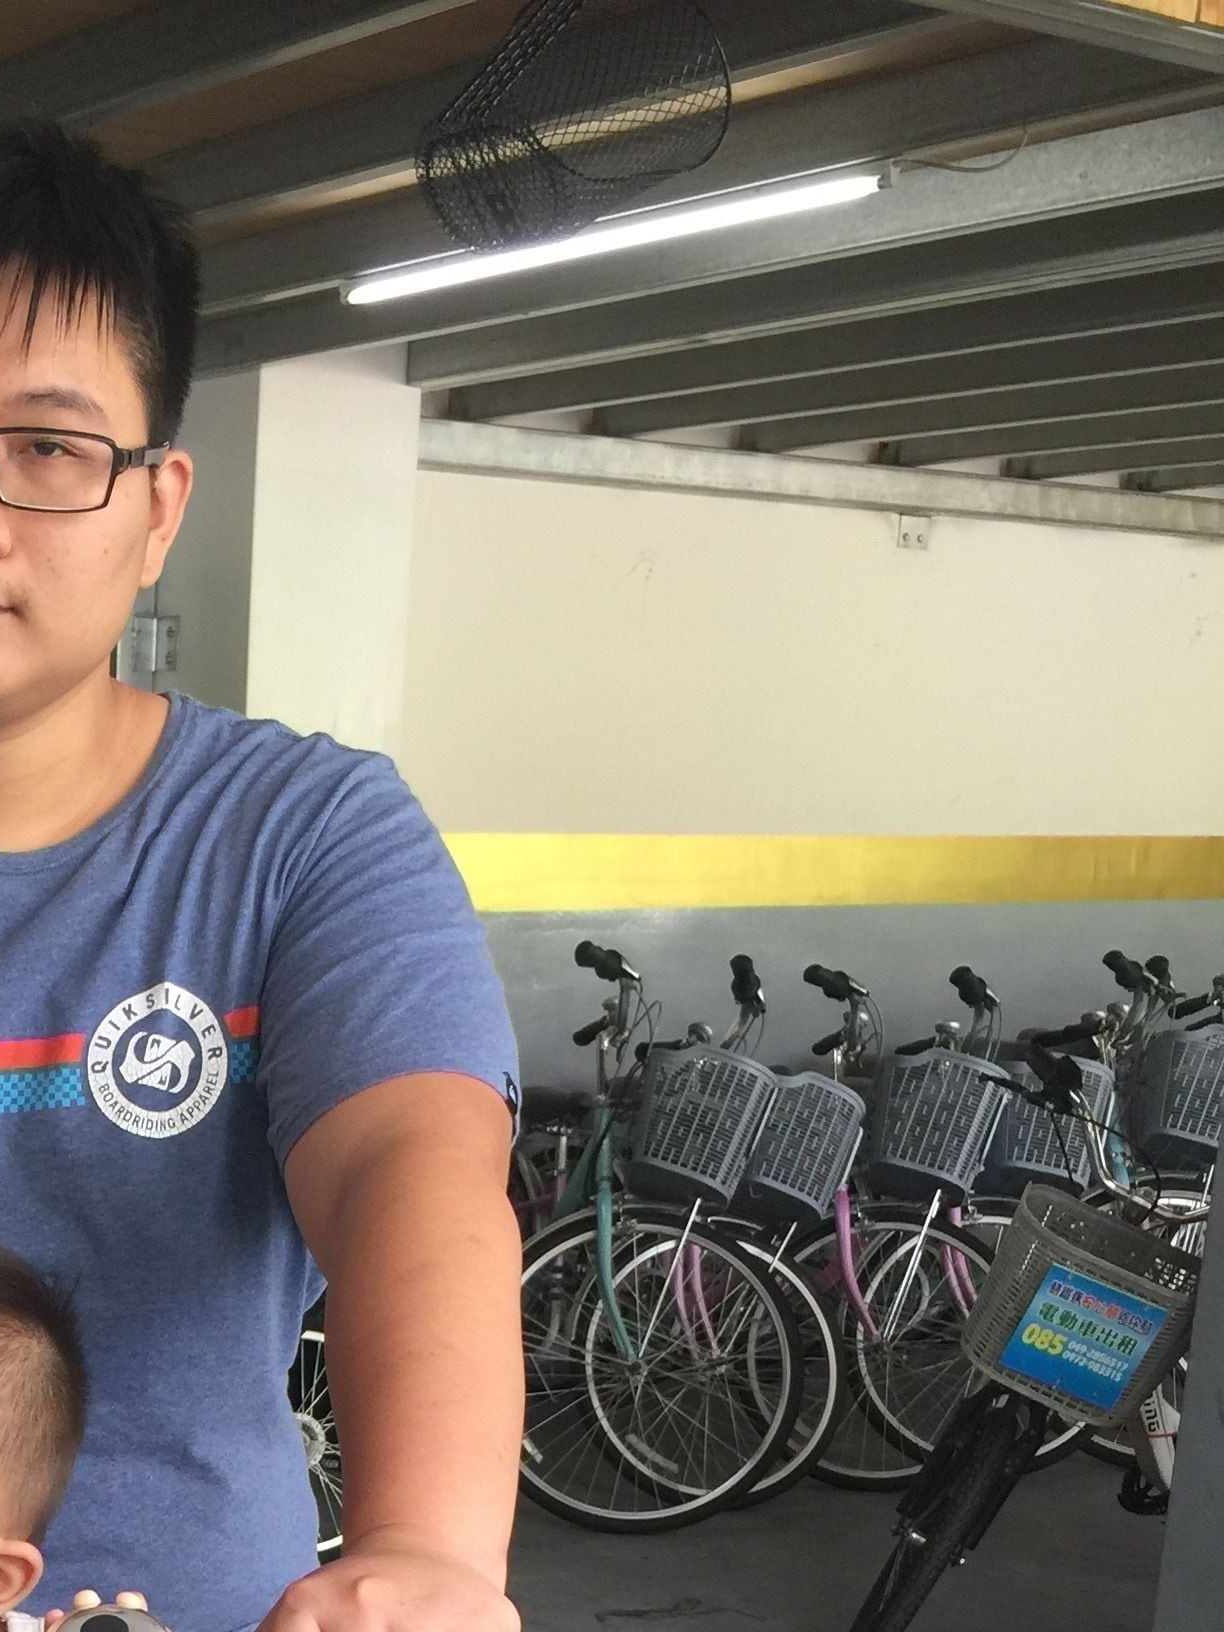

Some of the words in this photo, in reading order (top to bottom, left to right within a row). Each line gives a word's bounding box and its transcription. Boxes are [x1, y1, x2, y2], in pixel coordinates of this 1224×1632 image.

[91, 988, 223, 1073] QUIKSILVER
[99, 1082, 176, 1131] BOARDRIDING
[180, 1069, 219, 1124] APPAREL
[1022, 1323, 1067, 1355] 085
